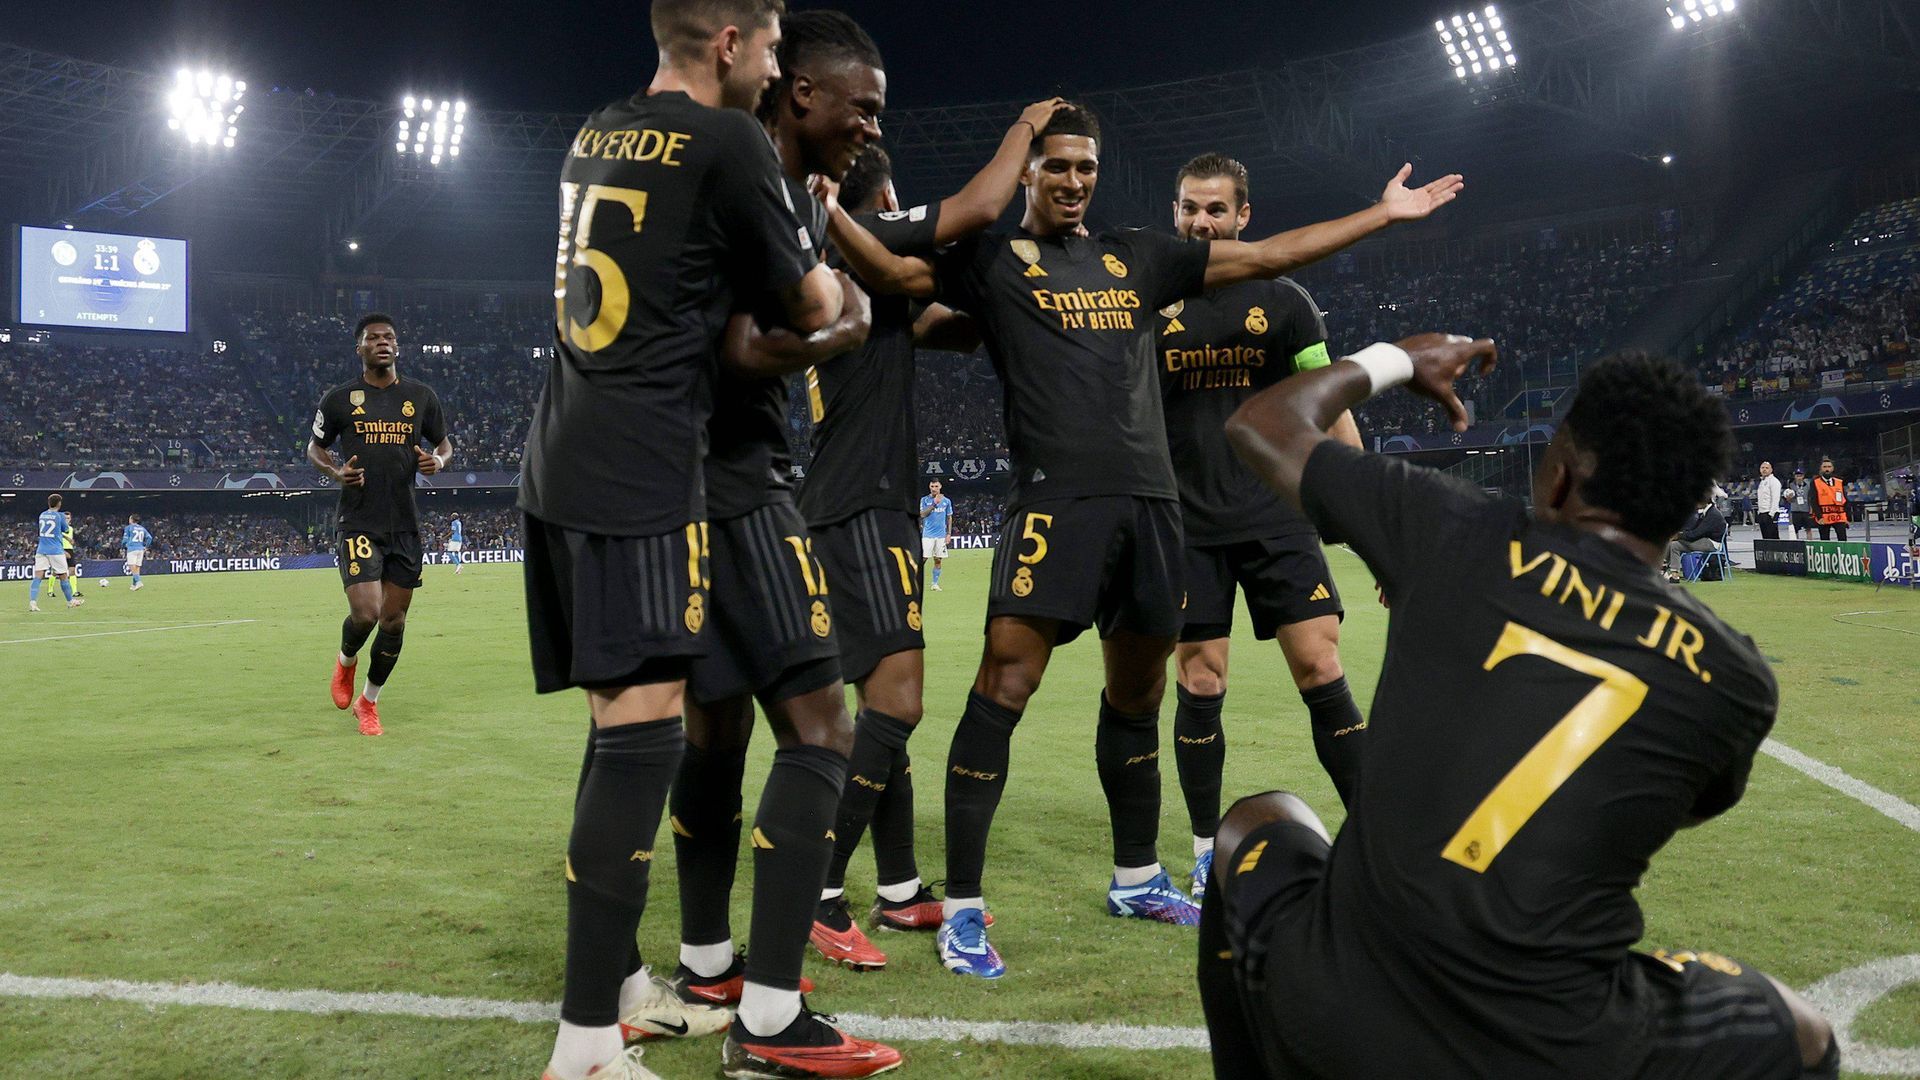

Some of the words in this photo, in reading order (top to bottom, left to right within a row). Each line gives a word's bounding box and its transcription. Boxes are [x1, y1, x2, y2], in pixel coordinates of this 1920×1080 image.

[94, 253, 120, 271] 1:1
[1032, 287, 1141, 311] Emirates
[76, 312, 119, 322] ATTEMPTS
[1062, 312, 1085, 330] FLY
[1088, 311, 1134, 330] BETTER
[1165, 343, 1266, 372] Emirates
[1205, 368, 1250, 389] BETTER
[354, 420, 414, 434] Emirates
[168, 440, 181, 449] 16
[365, 433, 379, 444] FLY
[380, 433, 407, 445] BETTER
[38, 519, 56, 538] 22
[132, 529, 144, 542] 20
[345, 534, 373, 561] 18
[951, 535, 992, 549] THAT
[1018, 512, 1053, 565] 5
[170, 560, 193, 572] THAT
[195, 557, 280, 571] #UCLFEELING
[421, 552, 438, 565] AT
[441, 549, 524, 565] #CLFEELIN
[1806, 546, 1860, 576] Heineken
[1509, 540, 1625, 631] VINI
[1636, 604, 1712, 684] JR.
[1441, 621, 1649, 873] 7
[852, 774, 886, 792] RMC
